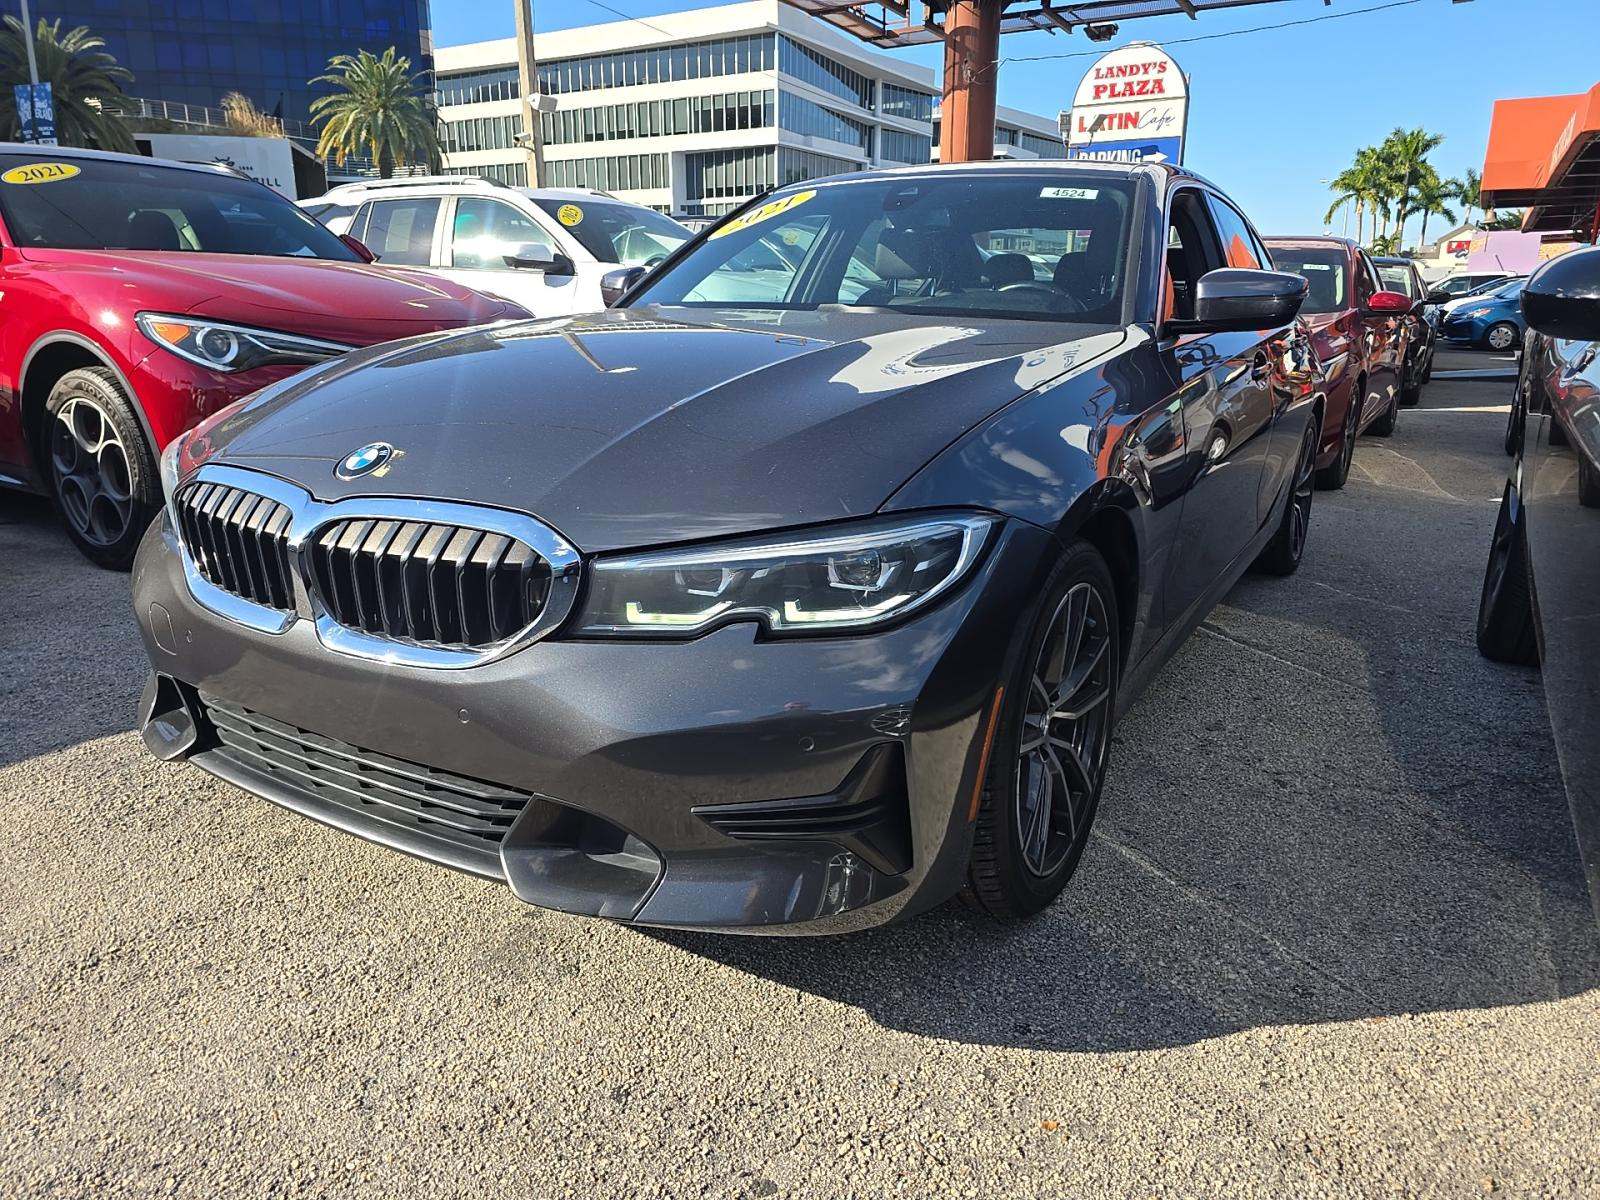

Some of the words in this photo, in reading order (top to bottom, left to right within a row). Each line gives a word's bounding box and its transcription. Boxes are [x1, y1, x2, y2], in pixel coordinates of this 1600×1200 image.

[1094, 60, 1168, 80] LANDY'S
[1093, 78, 1166, 100] PLAZA
[18, 165, 64, 181] 2021
[1052, 189, 1086, 197] 4524
